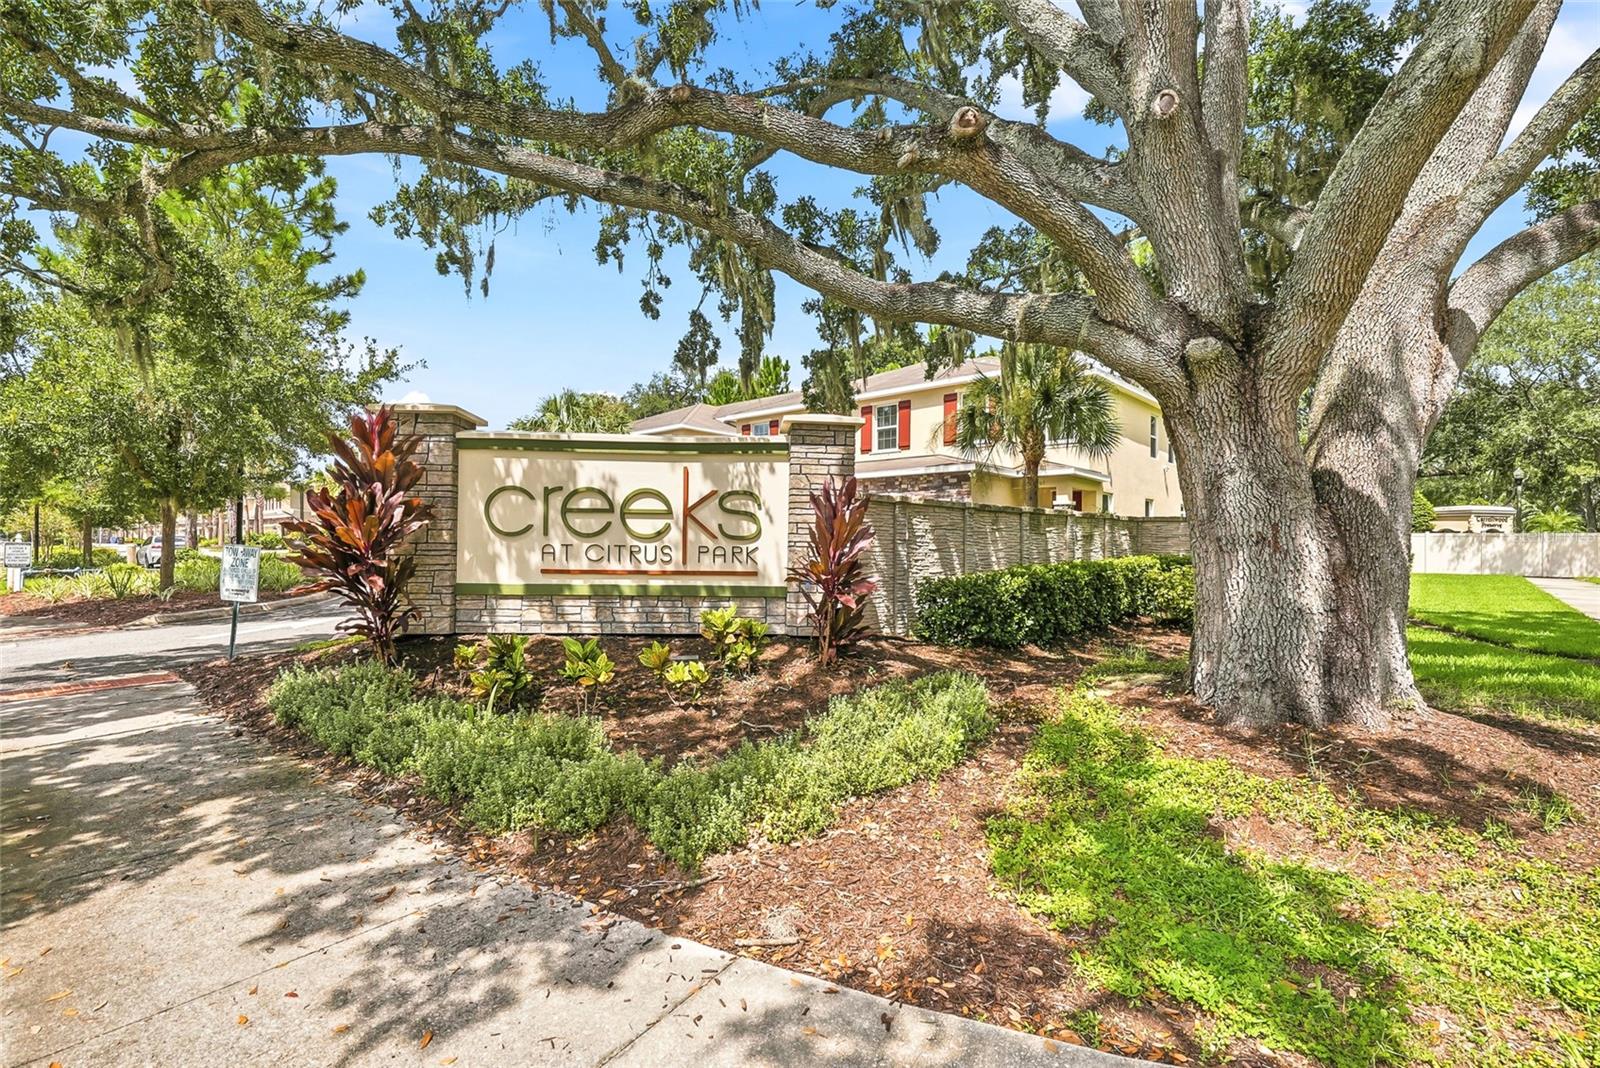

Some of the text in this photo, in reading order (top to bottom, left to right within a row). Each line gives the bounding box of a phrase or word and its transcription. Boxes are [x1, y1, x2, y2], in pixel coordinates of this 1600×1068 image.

[484, 466, 763, 565] creeks
[230, 558, 249, 568] ZONE
[541, 543, 759, 565] AT CITRUS PARK
